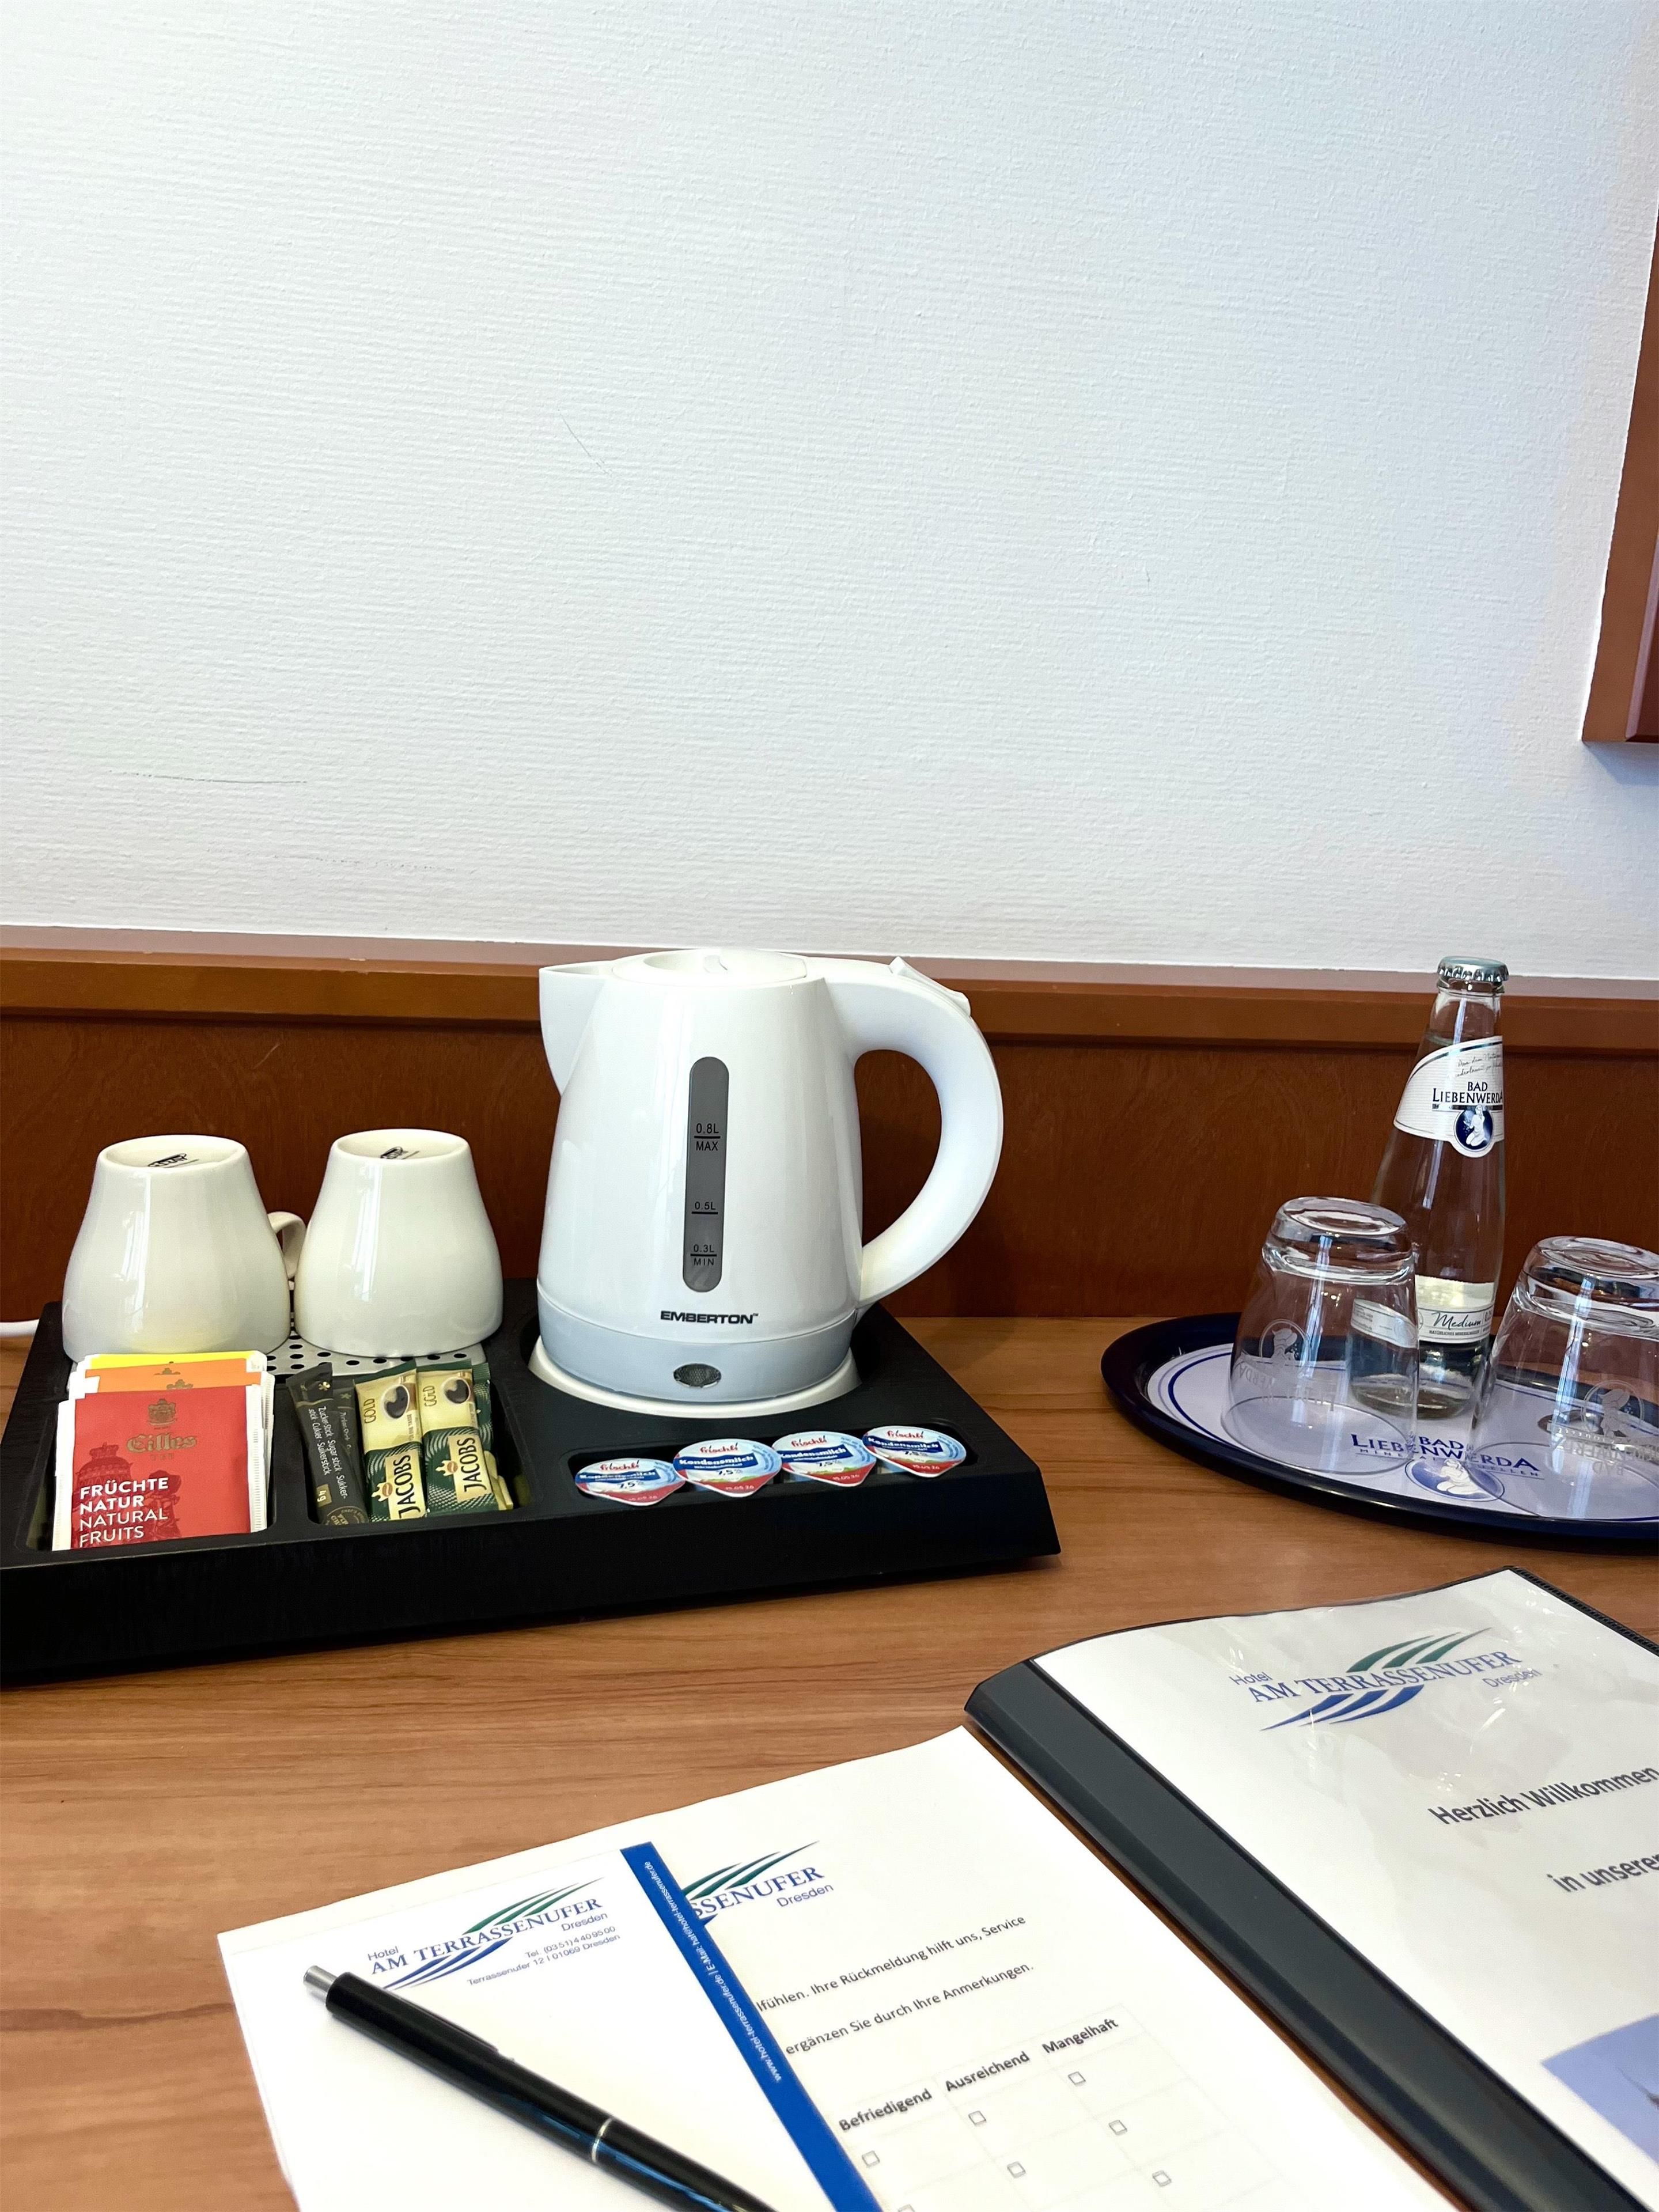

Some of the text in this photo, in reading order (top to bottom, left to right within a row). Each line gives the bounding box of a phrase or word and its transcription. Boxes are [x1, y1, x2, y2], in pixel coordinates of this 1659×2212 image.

[1433, 1088, 1502, 1104] LIEBENWERDA
[1468, 1082, 1488, 1092] BAD
[696, 1123, 719, 1134] 0.8L
[696, 1141, 718, 1151] MAX
[695, 1202, 715, 1210] 0.5L
[693, 1244, 714, 1252] 0.3L
[1431, 1312, 1481, 1330] Medium
[364, 1398, 376, 1423] GOLD
[126, 1433, 197, 1452] Eilles
[308, 1408, 319, 1420] stick
[317, 1442, 332, 1475] Suikerstick
[327, 1440, 338, 1456] Sugar
[1419, 1436, 1464, 1449] BAD
[332, 1457, 343, 1472] stick
[457, 1437, 487, 1492] JACOBS
[679, 1456, 753, 1465] Kondensmilch
[81, 1478, 168, 1499] FRÜCHTE
[317, 1490, 327, 1502] 4g
[393, 1455, 421, 1519] JACOBS
[79, 1495, 144, 1514] NATUR
[79, 1508, 168, 1531] NATURAL
[79, 1525, 144, 1548] FRUITS
[1229, 1672, 1272, 1686] Hotel
[1248, 1651, 1522, 1702] AM TERRASSENUFER
[1427, 1767, 1659, 1824] Herzlich Willkommen
[1547, 1874, 1586, 1892] in
[645, 1861, 700, 1946] hat@hotel-terrassenufer.de
[777, 1884, 834, 1907] Dresden
[561, 1912, 608, 1931] Dresden
[370, 1898, 603, 1975] AM TERRASSENUFER
[368, 1946, 400, 1961] Hotel
[467, 1963, 530, 1986] Terrassenufer
[533, 1957, 545, 1965] 12
[552, 1946, 581, 1960] 01069
[582, 1934, 620, 1950] Dresden
[696, 1945, 715, 1971] E-Mail:
[810, 1979, 839, 1995] Ihre
[839, 1950, 929, 1986] Rückmeldung
[926, 1940, 955, 1956] hilft
[955, 1932, 982, 1946] uns,
[981, 1915, 1027, 1937] Service
[786, 1963, 1034, 2055] ergänzen Sie durch Ihre Anmerkungen.
[714, 1974, 782, 2084] www.hotel-terrassenufer.de
[838, 2018, 1119, 2132] Befriedigend Ausreichend Mangelhaft
